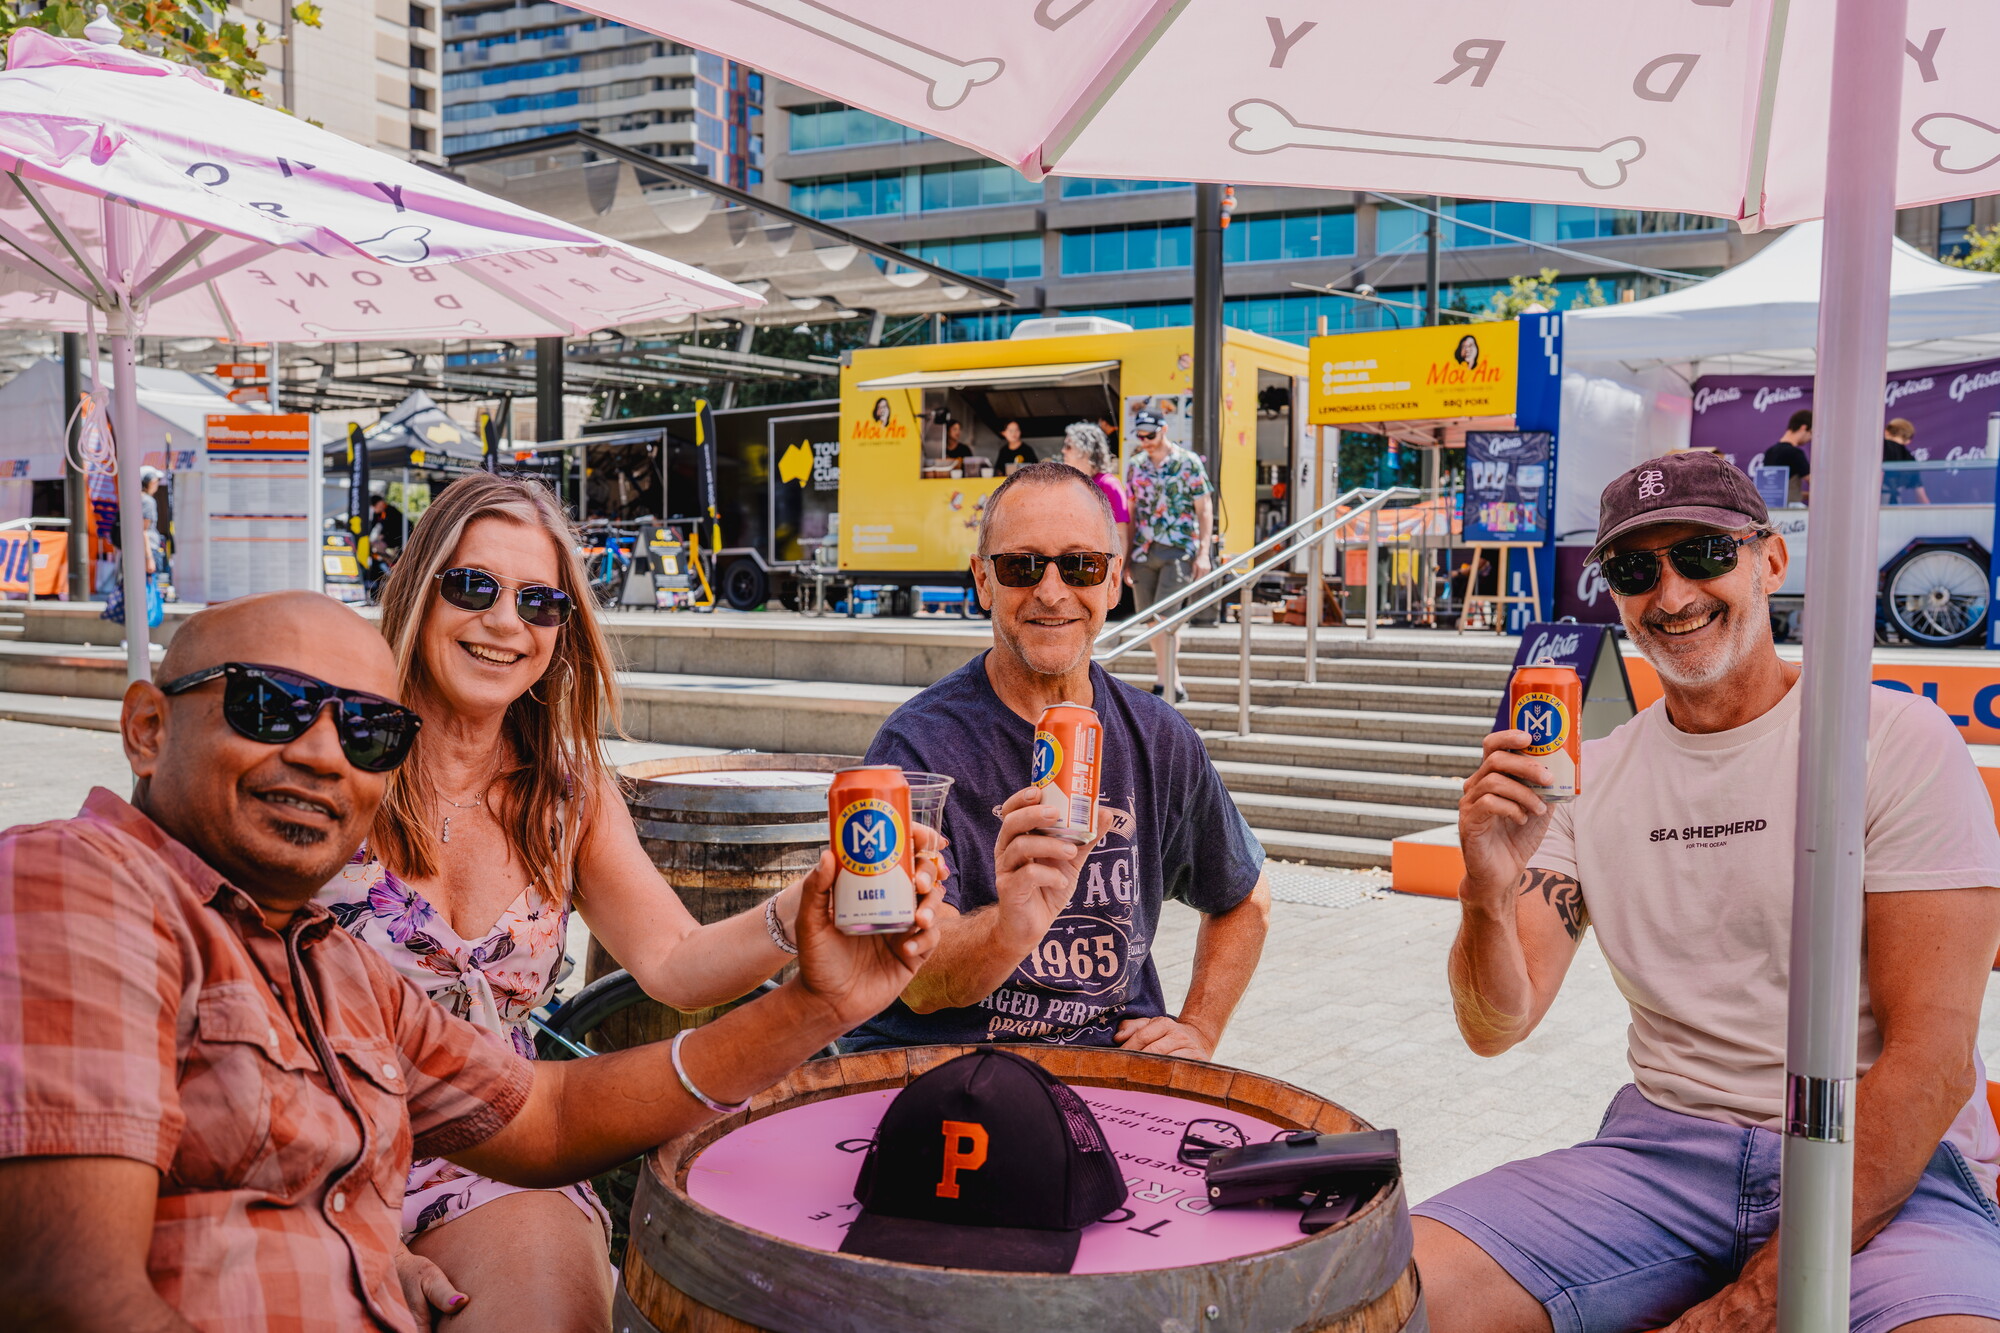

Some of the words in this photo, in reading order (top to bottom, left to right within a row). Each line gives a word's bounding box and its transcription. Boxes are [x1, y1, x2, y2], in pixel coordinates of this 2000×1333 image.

[1319, 404, 1376, 414] LEMONGRASS
[1379, 402, 1418, 411] CHICKEN
[1443, 400, 1462, 408] BBQ
[1465, 398, 1489, 406] PORK
[813, 442, 840, 456] TOU
[814, 456, 832, 468] DE
[814, 467, 840, 481] CUR
[1517, 694, 1562, 708] MISMATCH
[841, 801, 894, 819] MISMATCH
[1649, 828, 1678, 842] SEA
[1682, 819, 1767, 840] SHEPHERD
[841, 854, 887, 872] BREWING
[858, 889, 886, 901] LAGER
[1030, 932, 1119, 979] 1965
[936, 1120, 989, 1199] P
